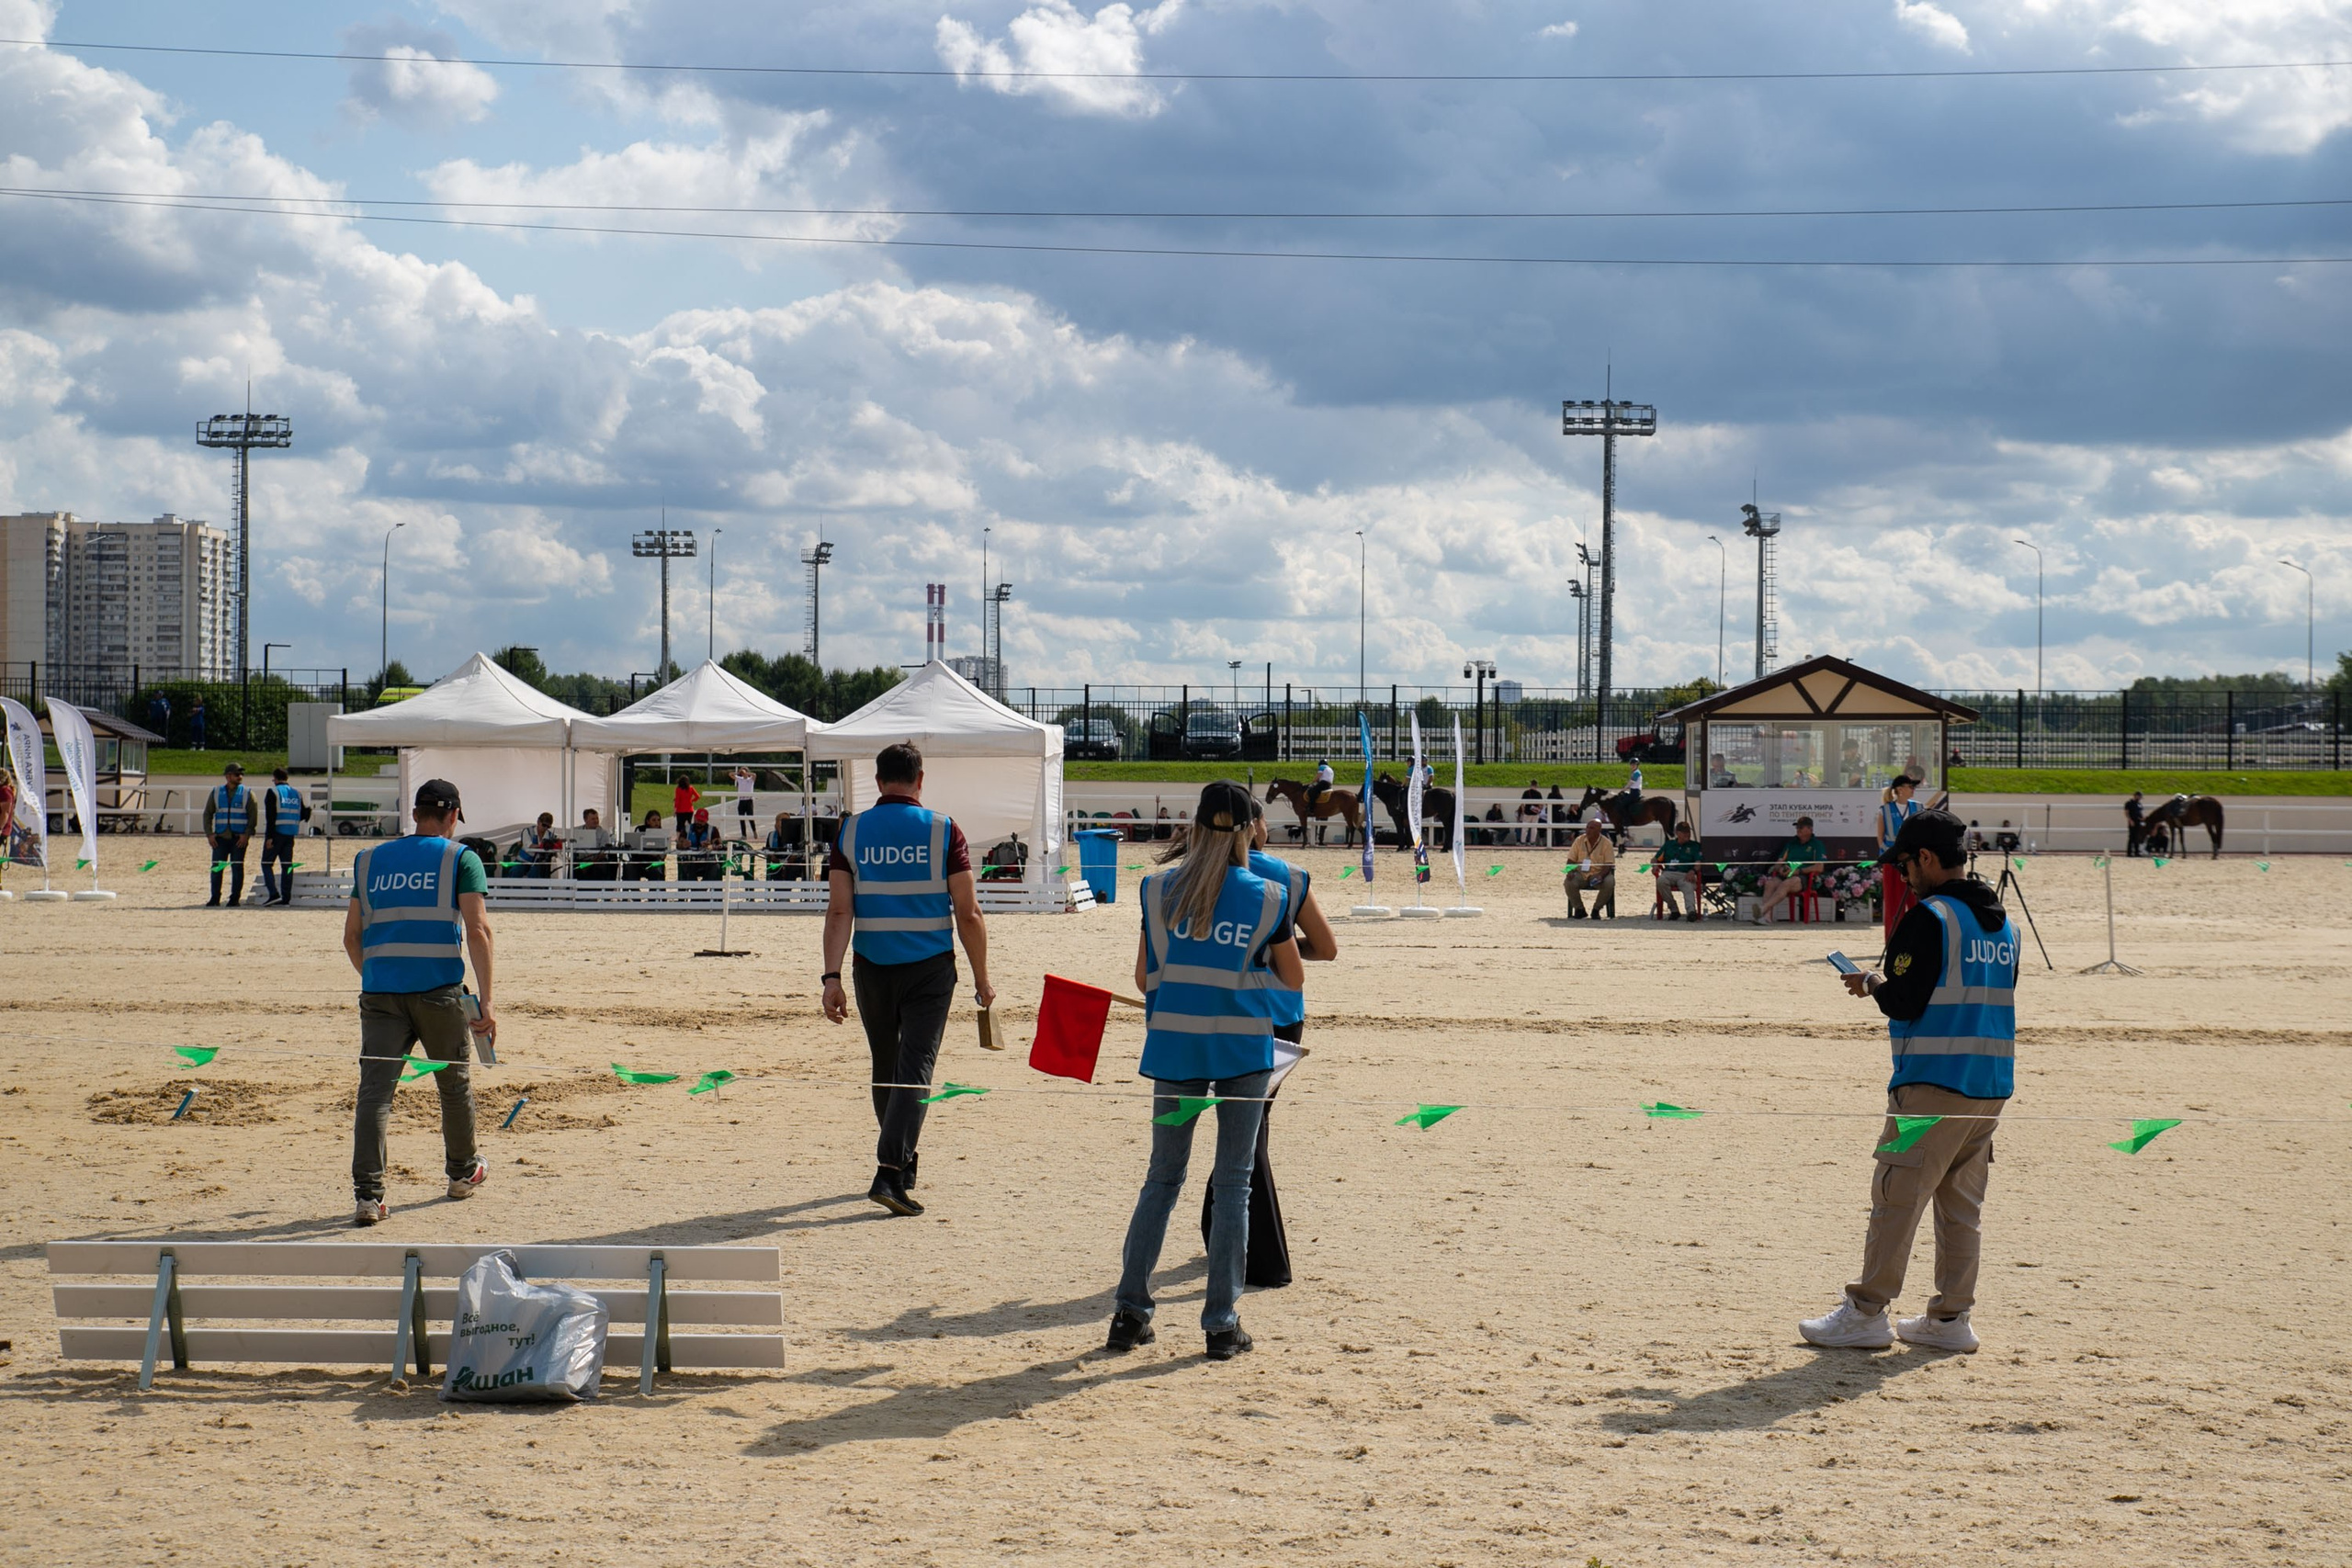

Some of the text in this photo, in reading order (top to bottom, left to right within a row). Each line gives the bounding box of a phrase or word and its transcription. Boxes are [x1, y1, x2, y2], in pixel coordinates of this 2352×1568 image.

[859, 845, 928, 865] JUDGE
[369, 872, 436, 893] JUDGE
[1173, 916, 1253, 948] UGE
[462, 1311, 480, 1325] Всё
[460, 1323, 520, 1337] выгодное,
[508, 1333, 535, 1349] тут!
